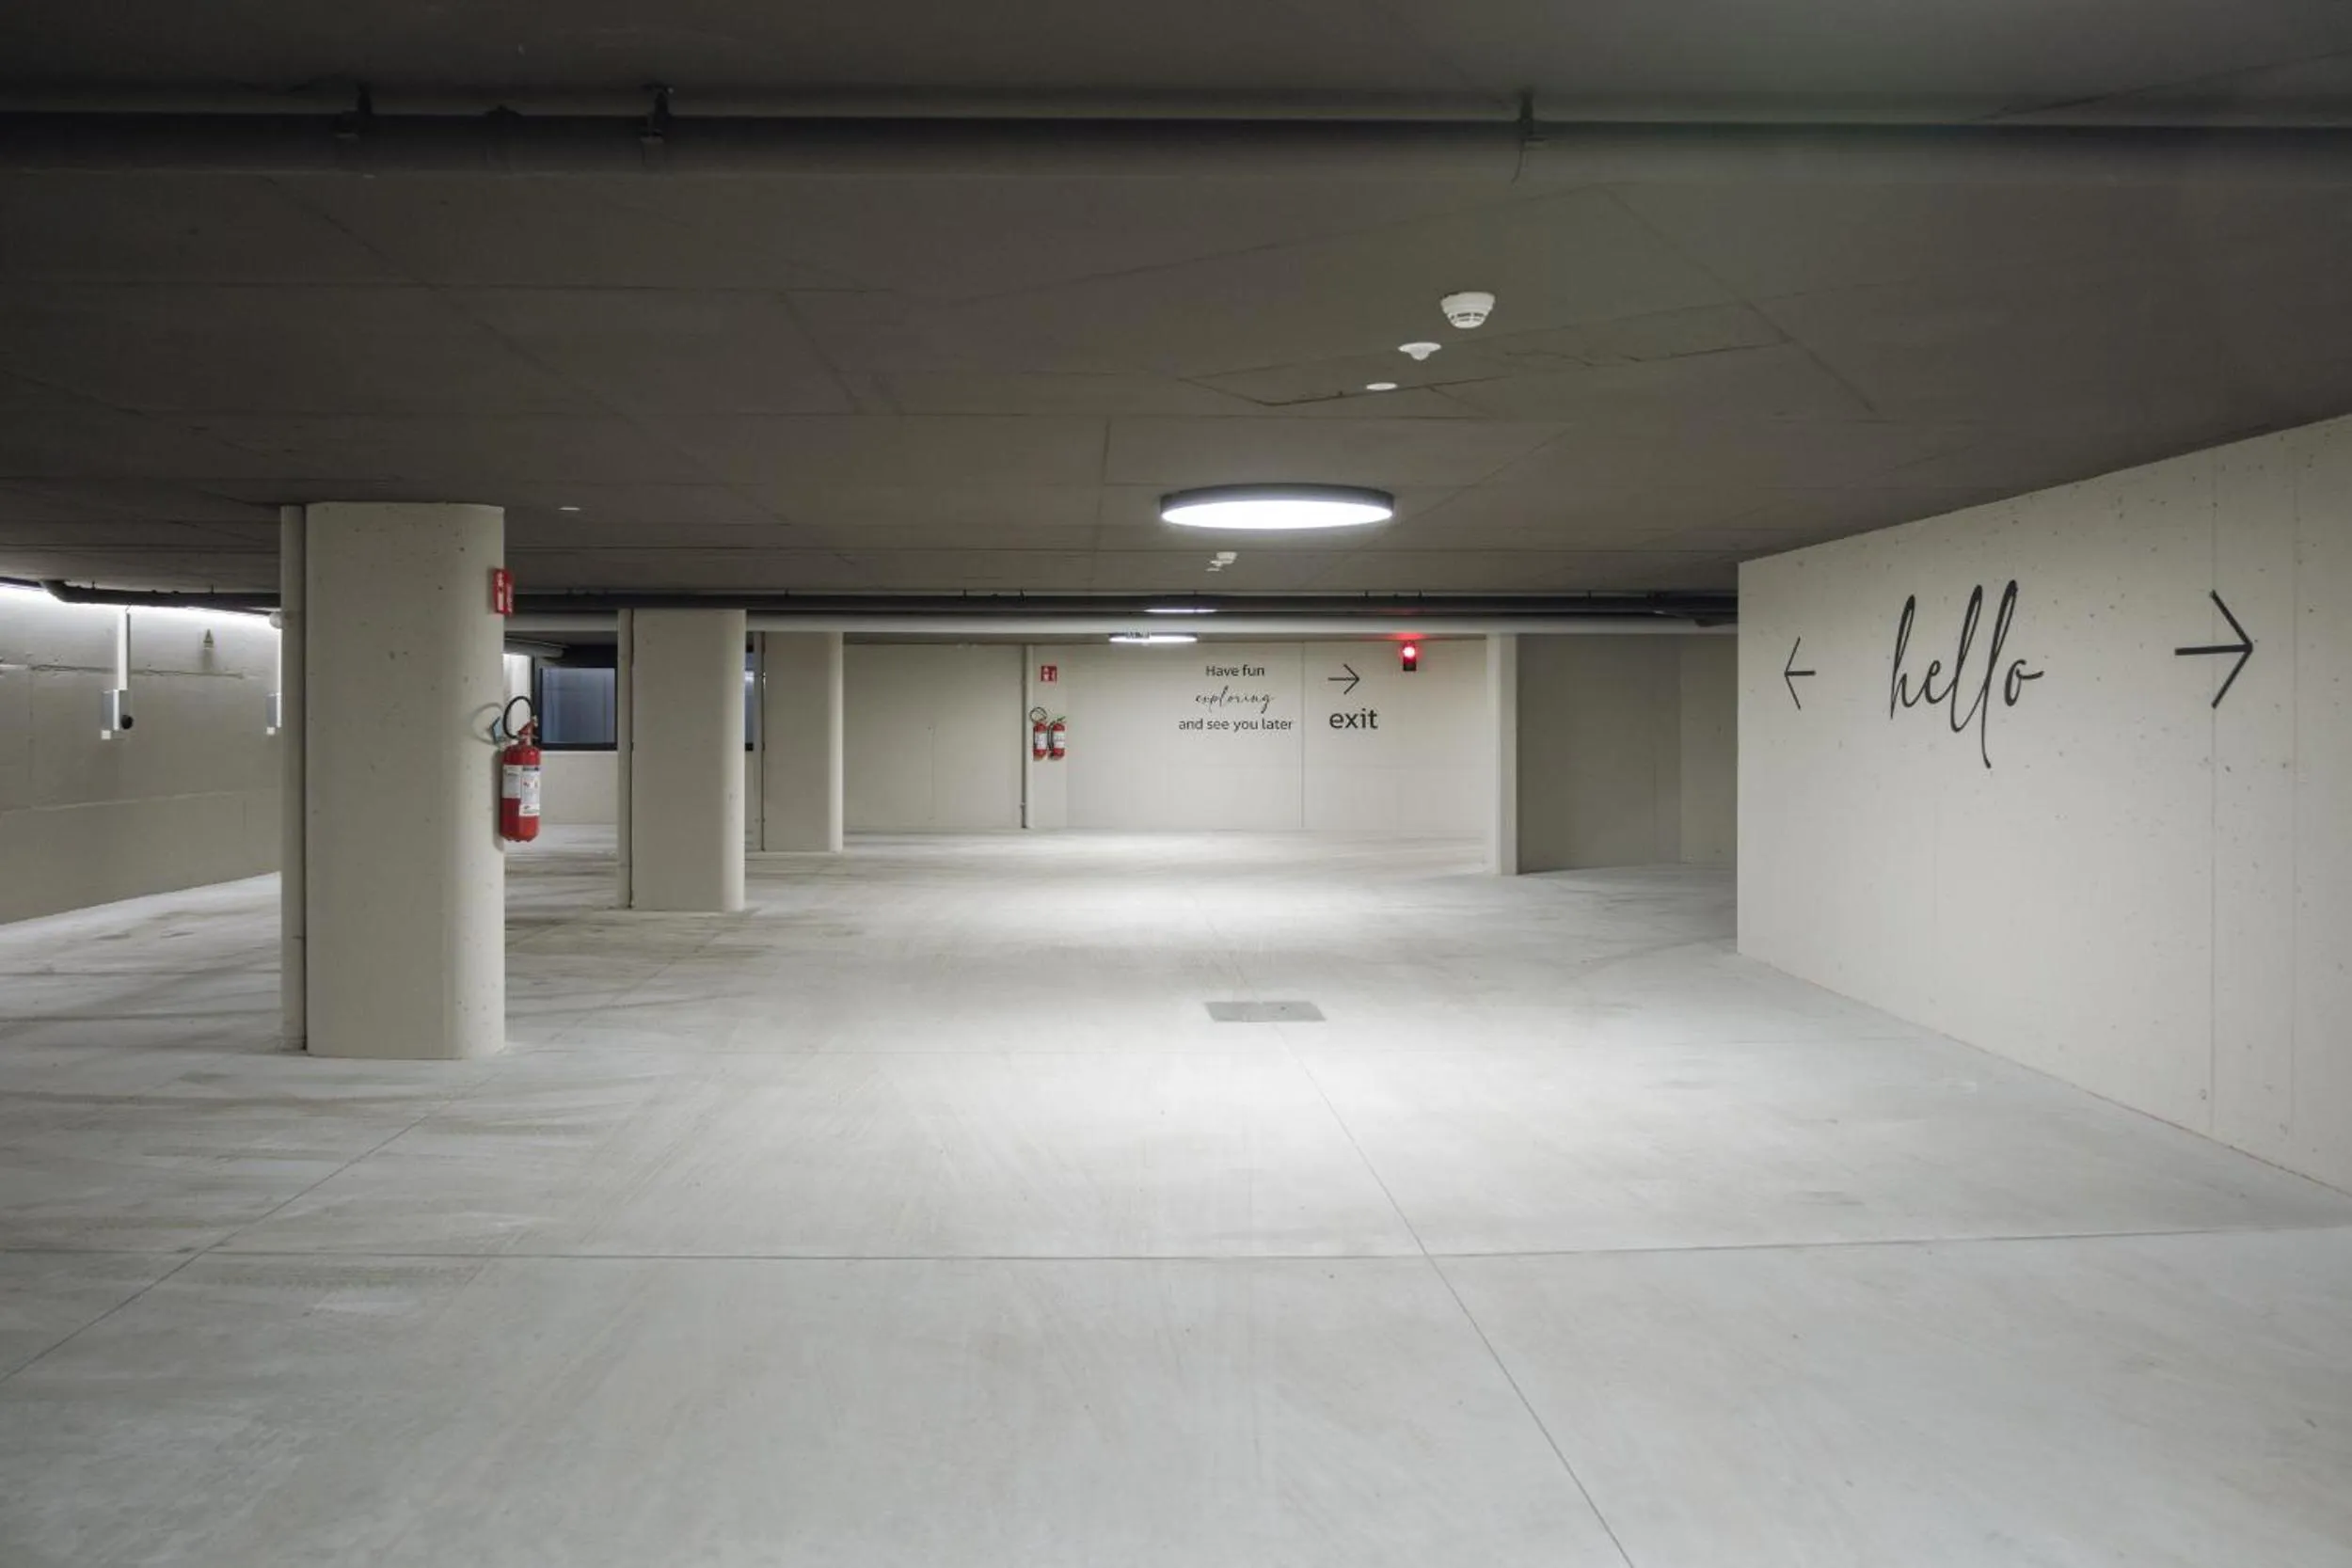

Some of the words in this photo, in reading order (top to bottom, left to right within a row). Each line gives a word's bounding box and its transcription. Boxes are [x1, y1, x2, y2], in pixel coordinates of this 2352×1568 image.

[1205, 665, 1240, 676] Have
[1242, 664, 1265, 676] fun
[1890, 579, 2044, 769] hello
[1195, 685, 1274, 714] exploring
[1178, 718, 1203, 730] and
[1206, 720, 1231, 730] see
[1232, 720, 1259, 733] you
[1262, 718, 1293, 730] later
[1328, 707, 1378, 729] exit
